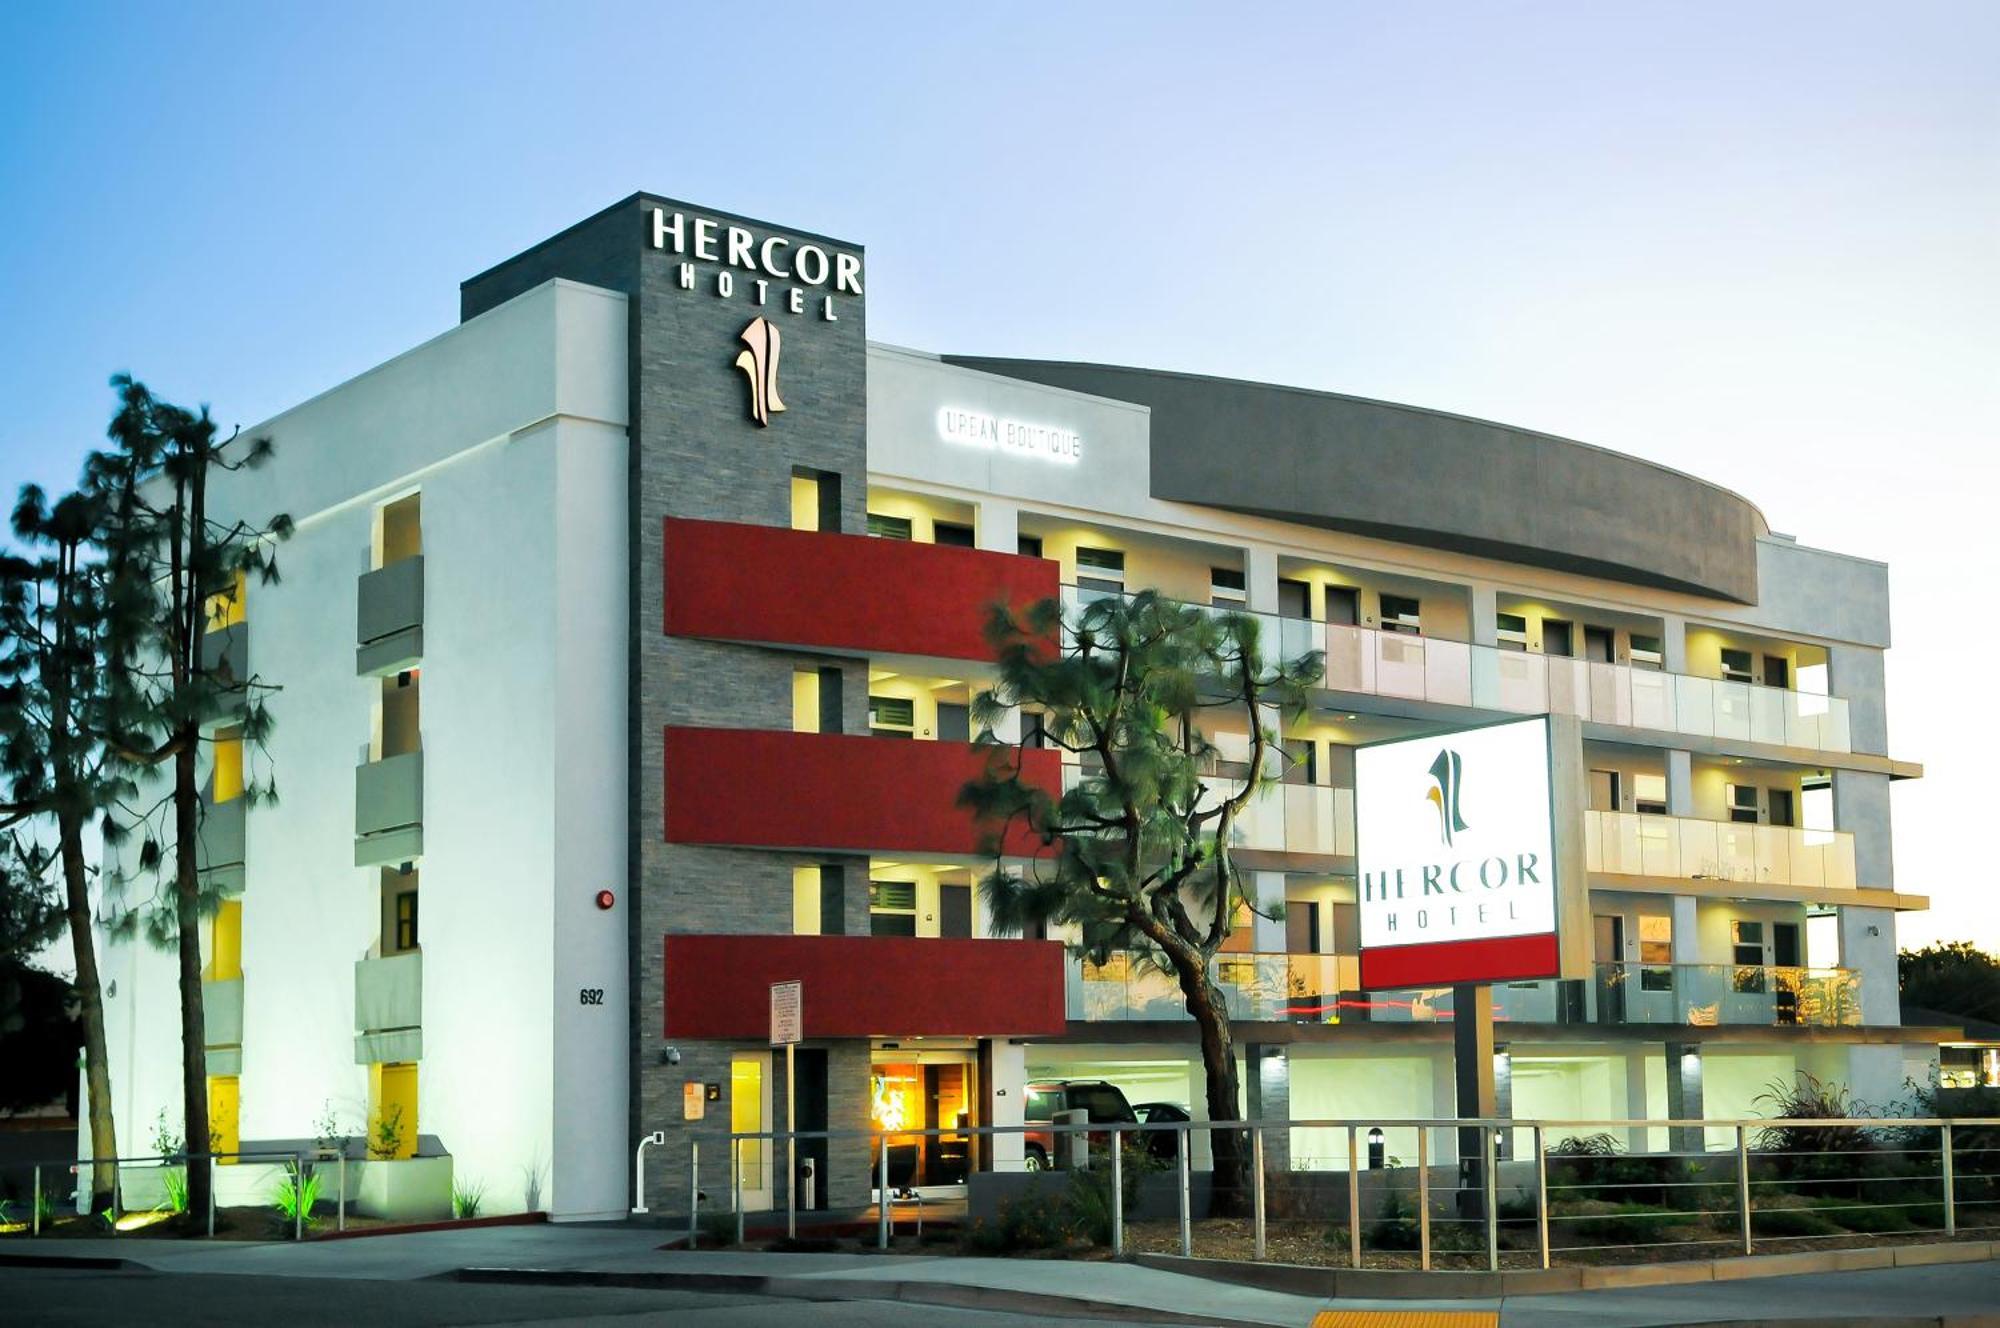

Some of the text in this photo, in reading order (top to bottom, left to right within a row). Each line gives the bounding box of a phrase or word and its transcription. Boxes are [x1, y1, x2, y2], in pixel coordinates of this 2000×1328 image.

[653, 207, 863, 295] HERCOR
[680, 262, 838, 322] HOTEL
[1007, 423, 1081, 458] BOUTIQUE
[1365, 853, 1541, 902] HERCOR
[1388, 901, 1520, 932] HOTEL
[580, 988, 604, 1006] 692
